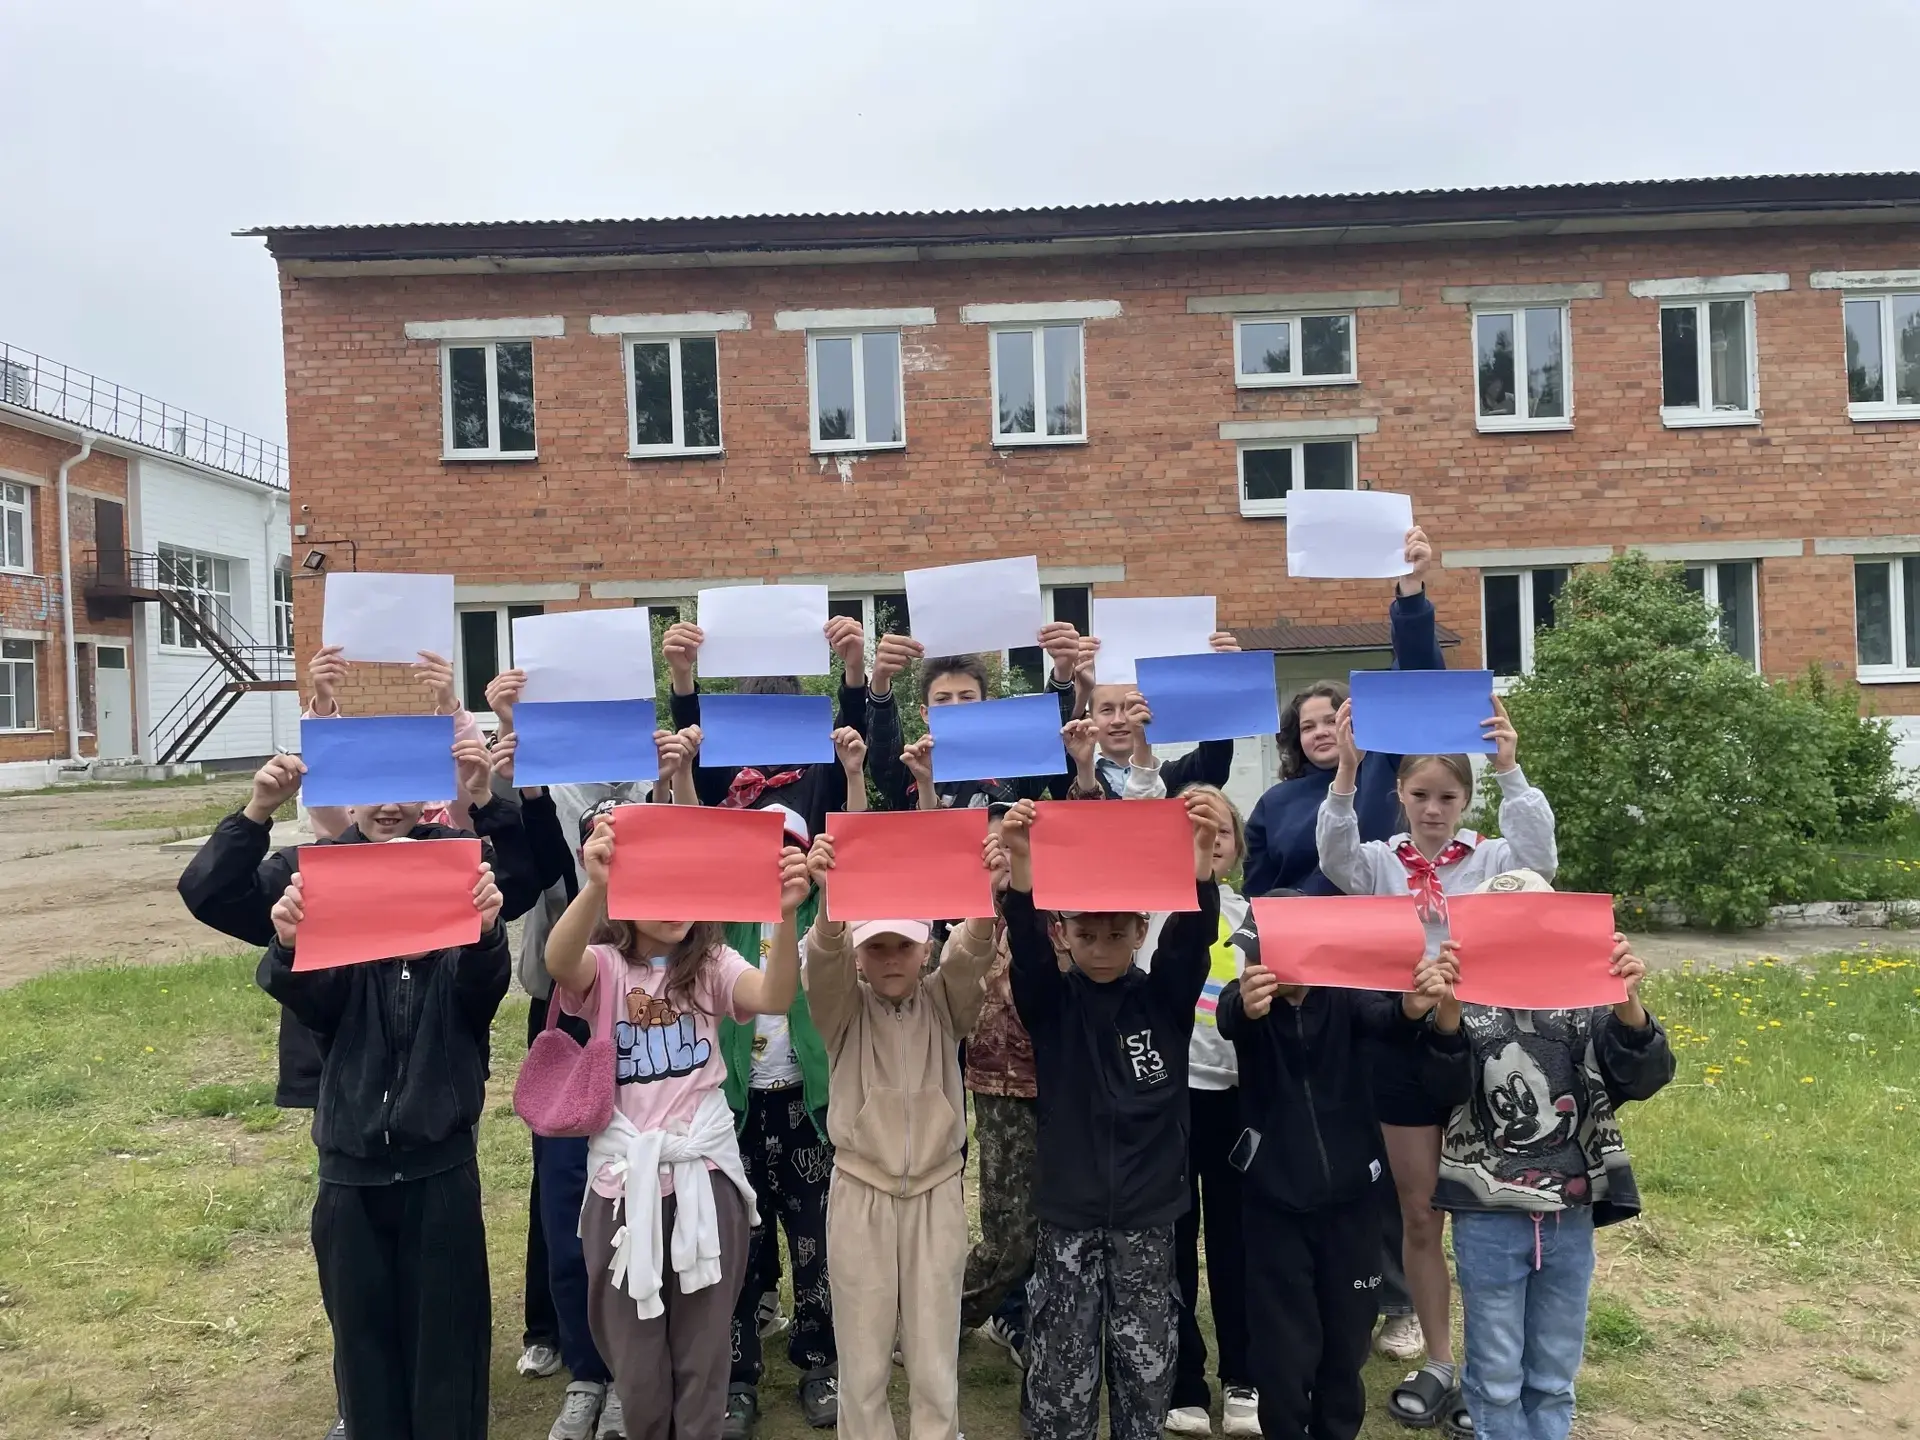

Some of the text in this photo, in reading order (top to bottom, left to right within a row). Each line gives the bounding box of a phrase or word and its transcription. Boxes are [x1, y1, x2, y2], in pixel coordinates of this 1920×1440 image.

[616, 1012, 712, 1086] CHILL
[1126, 1029, 1152, 1056] S7
[1131, 1050, 1164, 1078] R3
